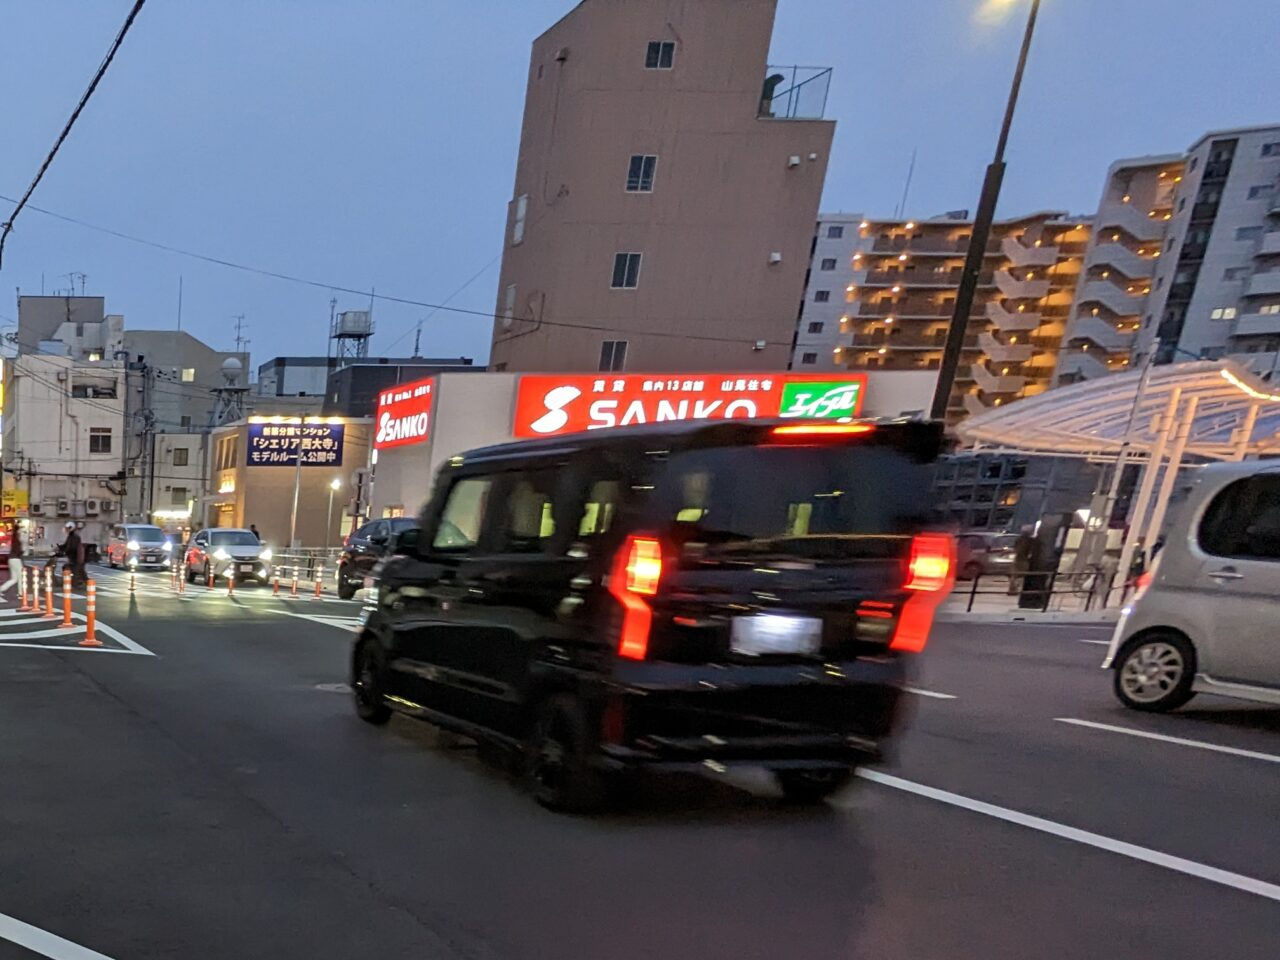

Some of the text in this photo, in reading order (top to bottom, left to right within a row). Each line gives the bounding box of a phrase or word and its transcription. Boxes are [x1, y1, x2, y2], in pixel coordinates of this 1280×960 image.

[385, 412, 429, 442] SANKO
[586, 399, 757, 430] SANKO
[252, 438, 338, 450] 「シエリア西大寺」
